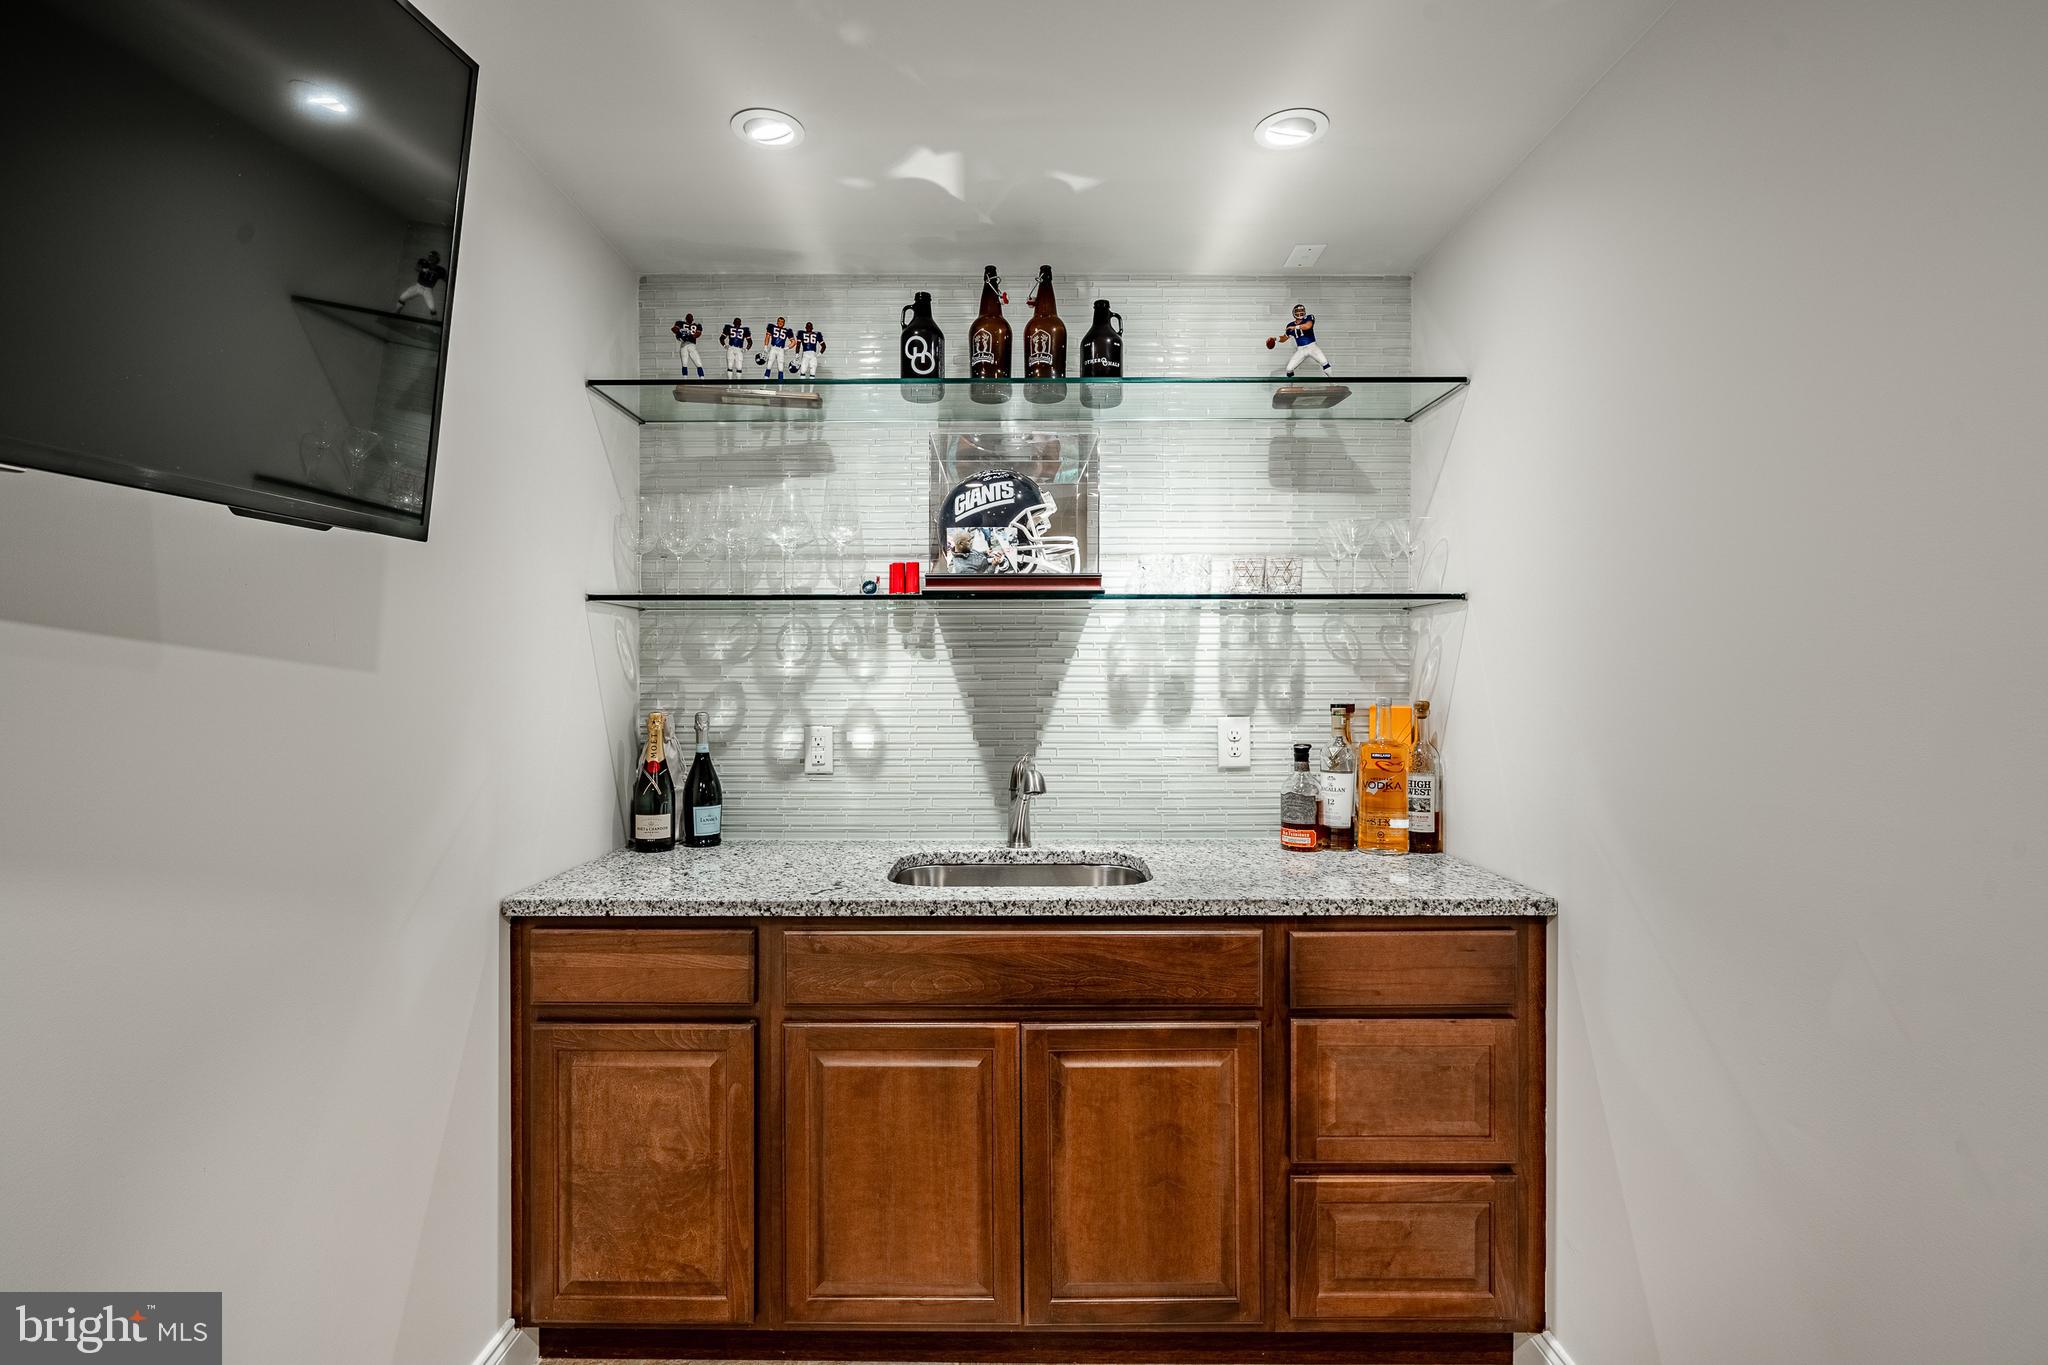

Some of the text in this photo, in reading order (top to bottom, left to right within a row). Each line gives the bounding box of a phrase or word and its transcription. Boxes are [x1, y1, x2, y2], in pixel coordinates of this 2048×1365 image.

[683, 323, 697, 335] 58
[730, 327, 744, 339] 53
[773, 327, 786, 340] 55
[803, 333, 817, 344] 56
[954, 481, 1015, 516] GIANTS
[1363, 781, 1402, 791] VODKA
[1408, 780, 1431, 788] HIGH
